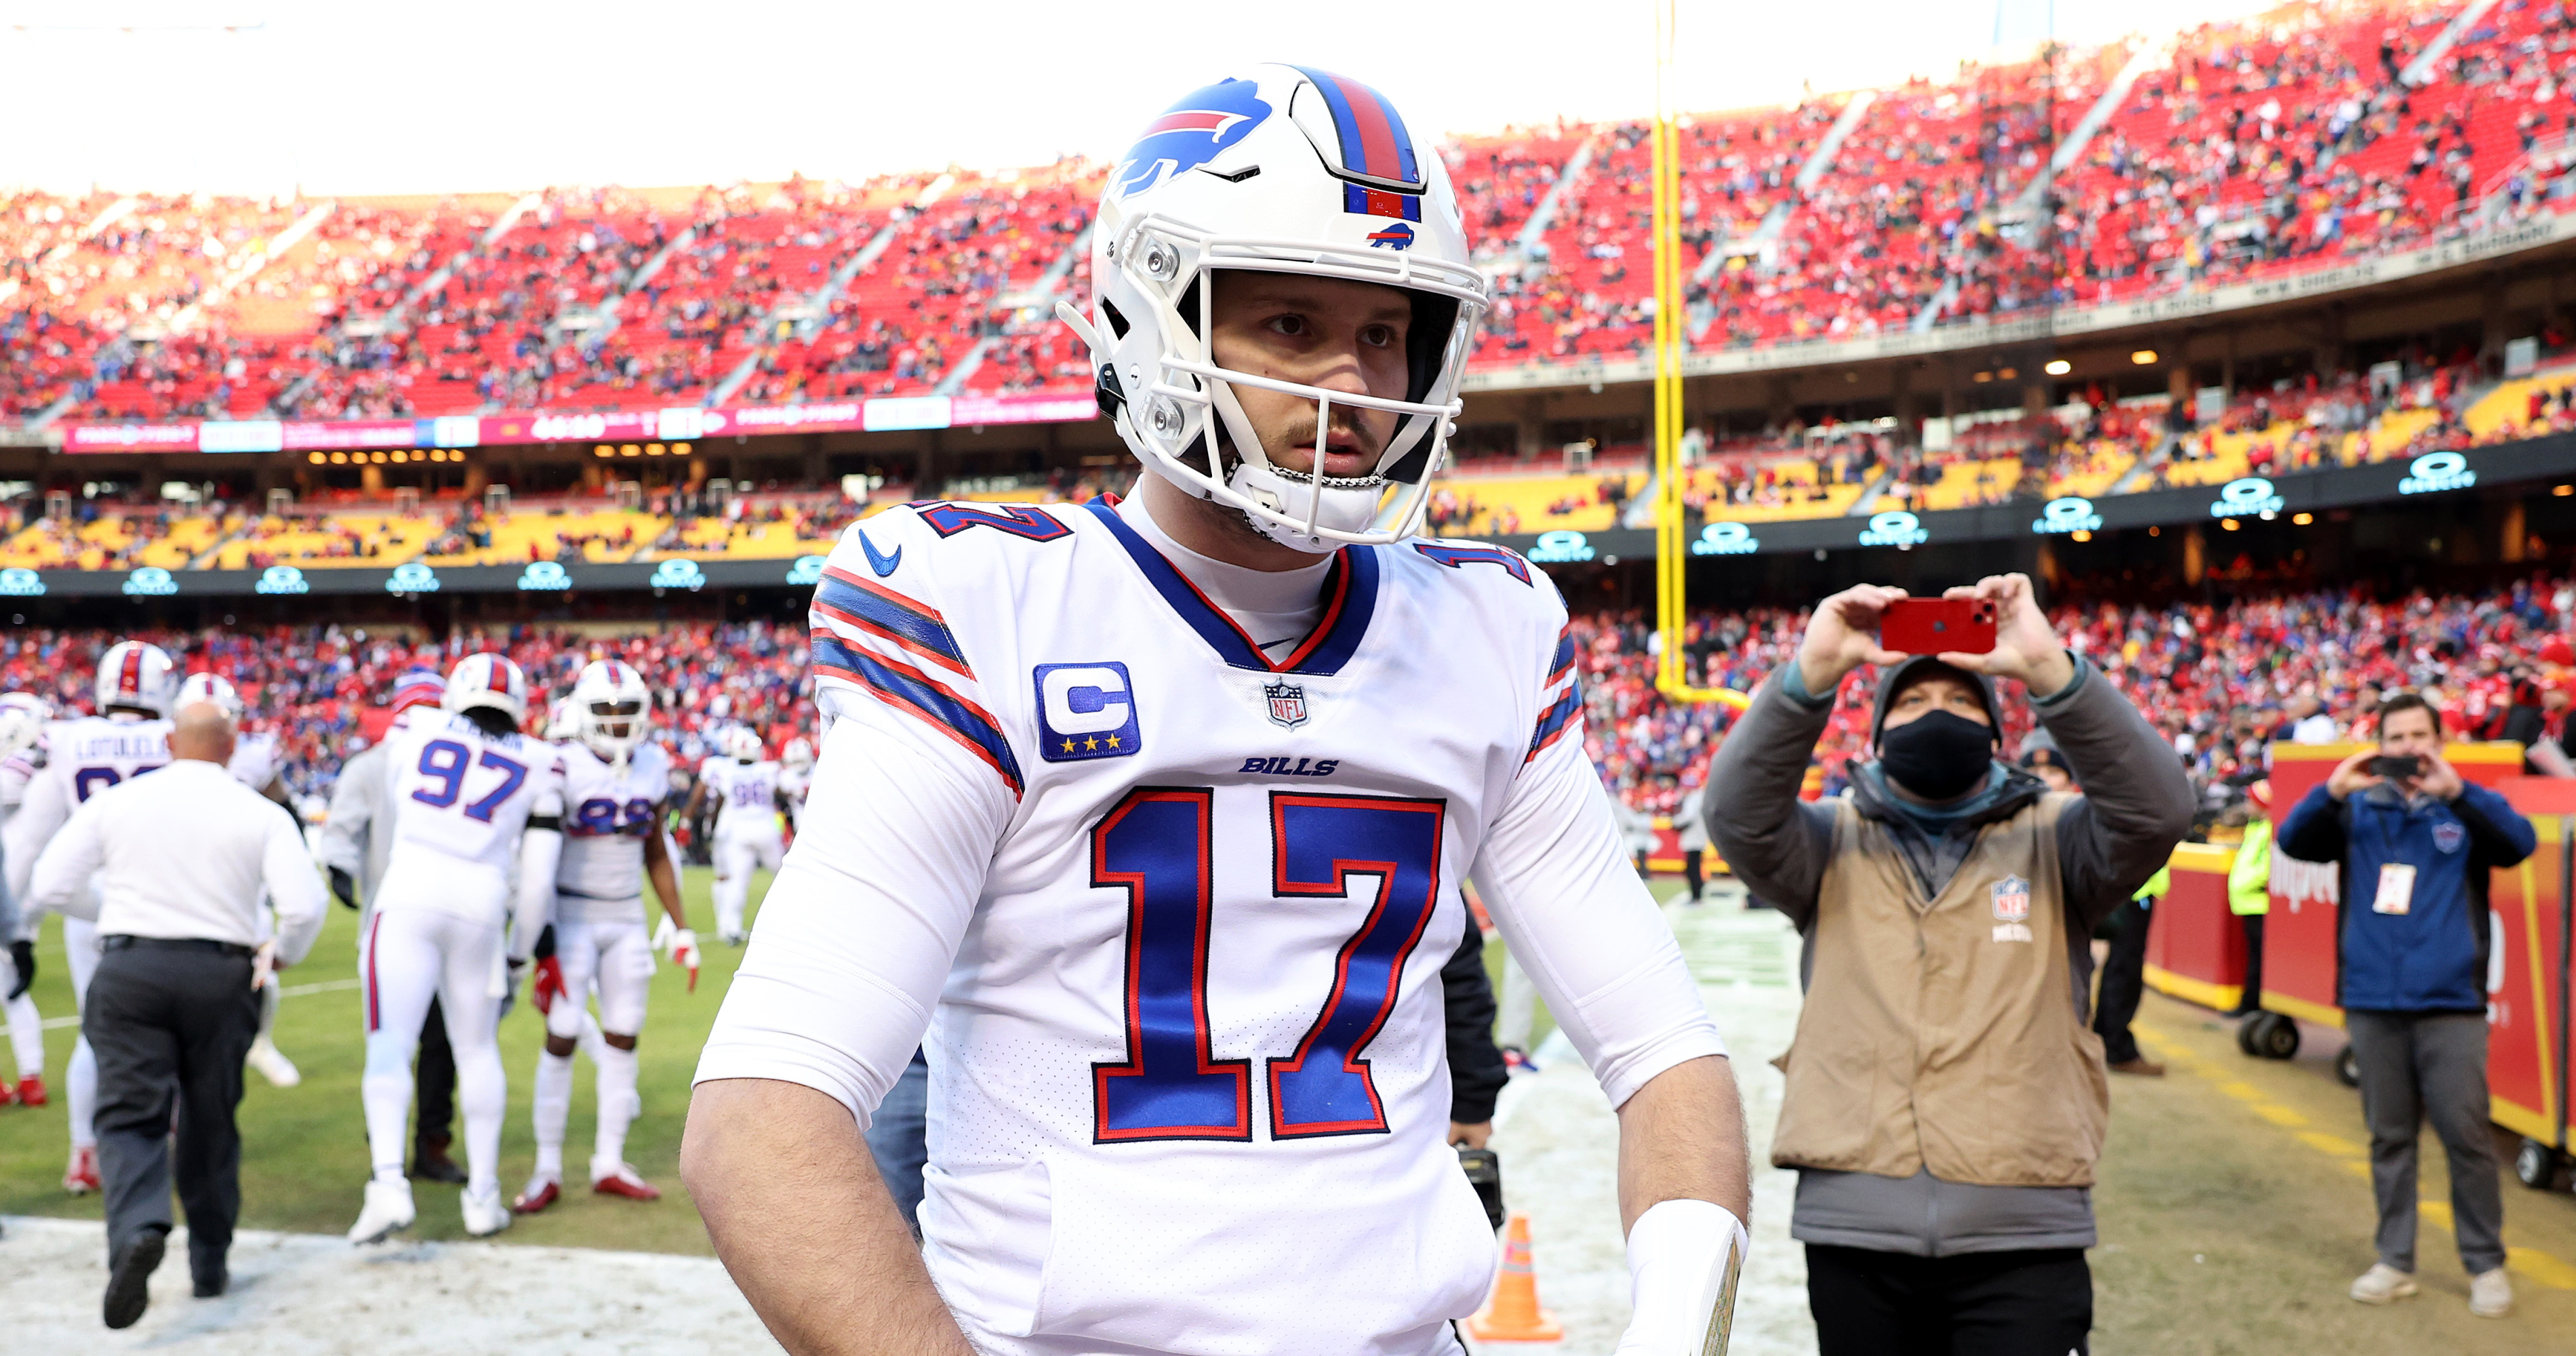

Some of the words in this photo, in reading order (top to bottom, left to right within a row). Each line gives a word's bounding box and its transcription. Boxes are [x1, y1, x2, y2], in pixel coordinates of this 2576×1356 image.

[1042, 667, 1129, 735] C
[1272, 699, 1304, 720] NFL
[411, 739, 528, 823] 97
[1238, 757, 1340, 776] BILLS
[1996, 894, 2028, 916] NFL
[1090, 786, 1447, 1145] 17
